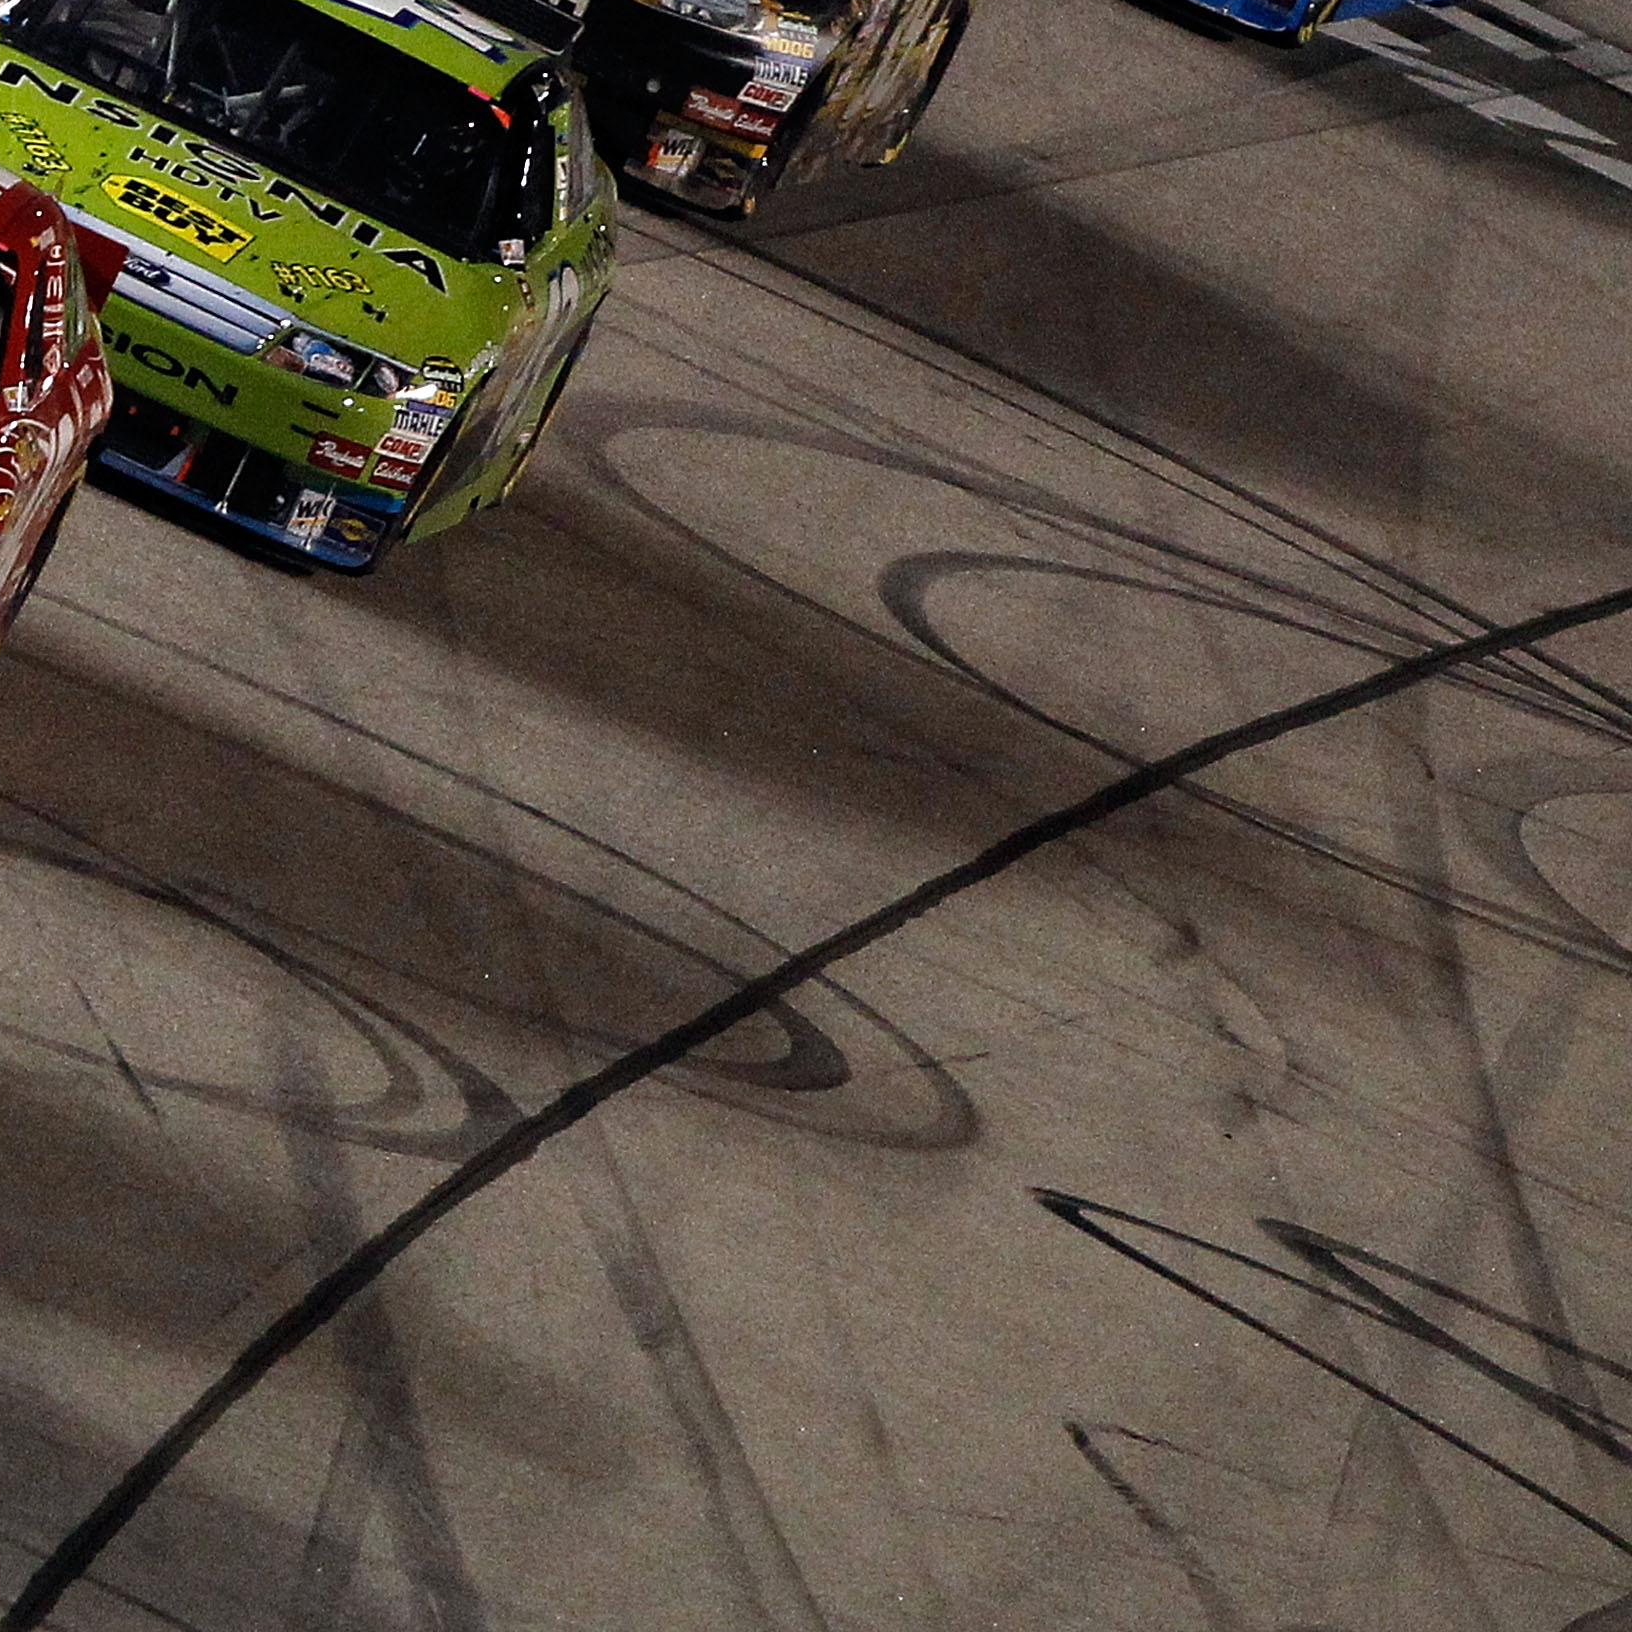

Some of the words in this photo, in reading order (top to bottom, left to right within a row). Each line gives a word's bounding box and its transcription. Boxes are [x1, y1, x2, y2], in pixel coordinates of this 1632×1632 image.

[763, 37, 814, 58] MOOG
[128, 146, 282, 222] HDTV
[118, 192, 224, 253] BUY
[122, 179, 248, 247] BEST
[271, 261, 371, 294] #1163
[395, 410, 443, 437] MAHLE
